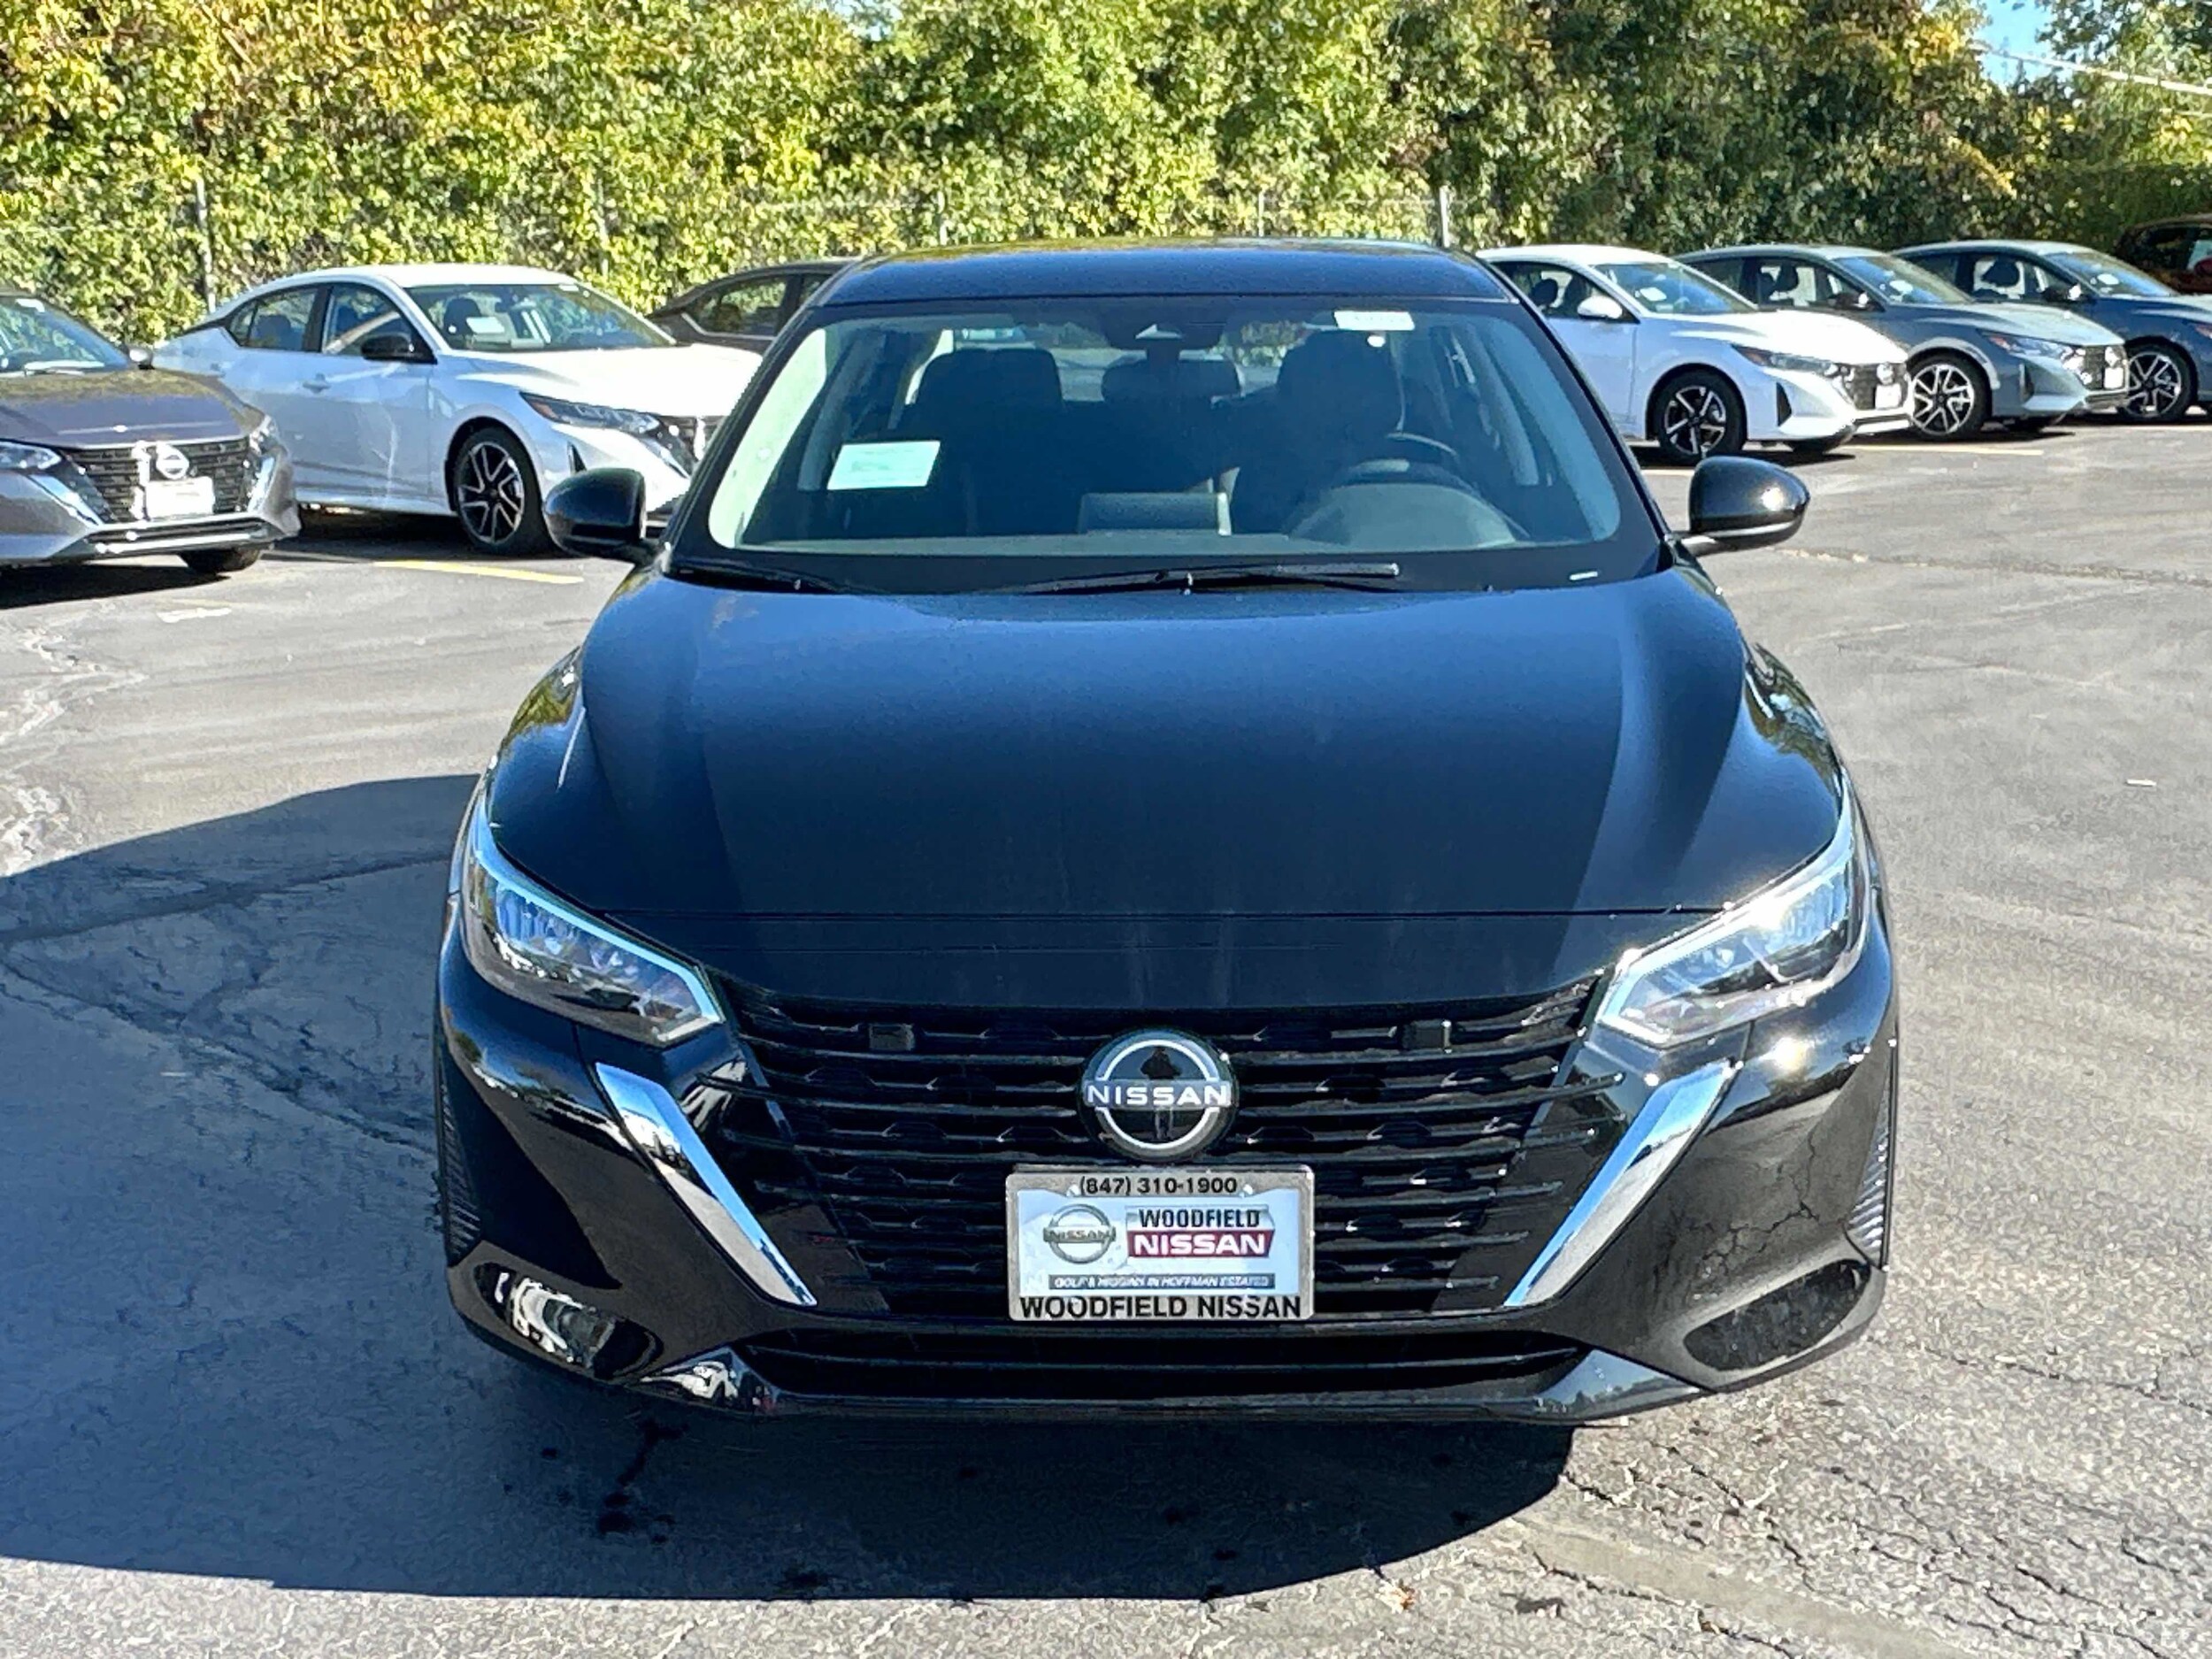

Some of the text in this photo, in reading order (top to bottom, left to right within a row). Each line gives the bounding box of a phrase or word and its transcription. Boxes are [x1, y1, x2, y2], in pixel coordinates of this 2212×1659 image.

[1087, 1085, 1230, 1106] NISSAN
[1079, 1176, 1238, 1195] (847) 310-1900
[1139, 1209, 1260, 1228] WOODFIELD
[1134, 1233, 1265, 1255] NISSAN
[1019, 1296, 1301, 1318] WOODFIELD NISSAN
